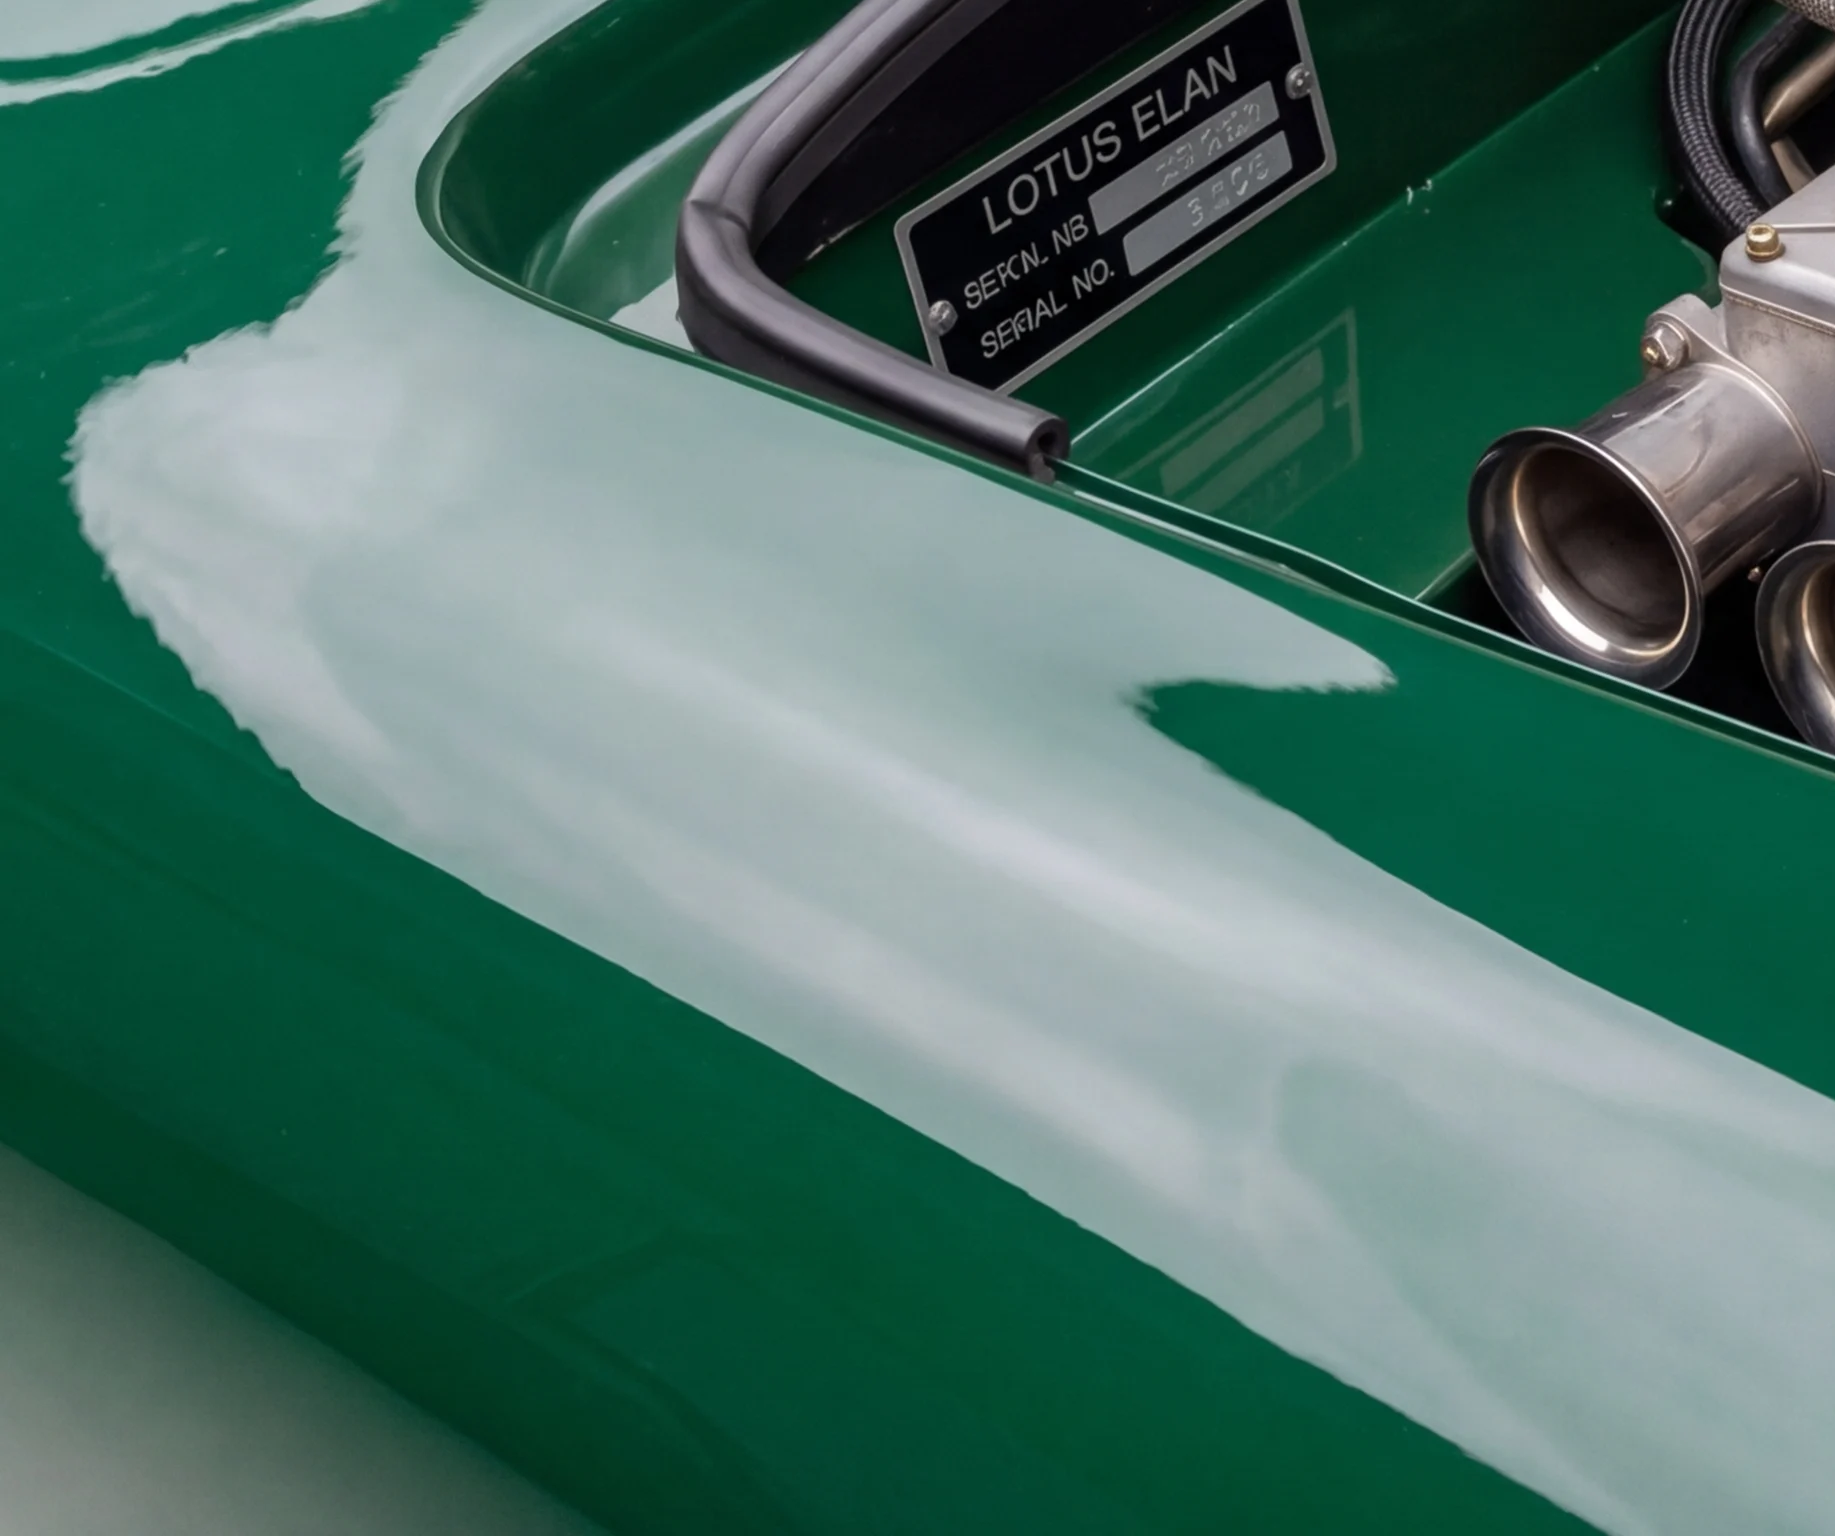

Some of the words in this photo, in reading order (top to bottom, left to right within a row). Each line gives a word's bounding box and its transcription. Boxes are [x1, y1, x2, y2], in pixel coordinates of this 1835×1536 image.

[981, 119, 1122, 235] LOTUS
[1131, 44, 1238, 142] ELAN
[1051, 213, 1089, 255] NB
[1071, 258, 1116, 300] NO.
